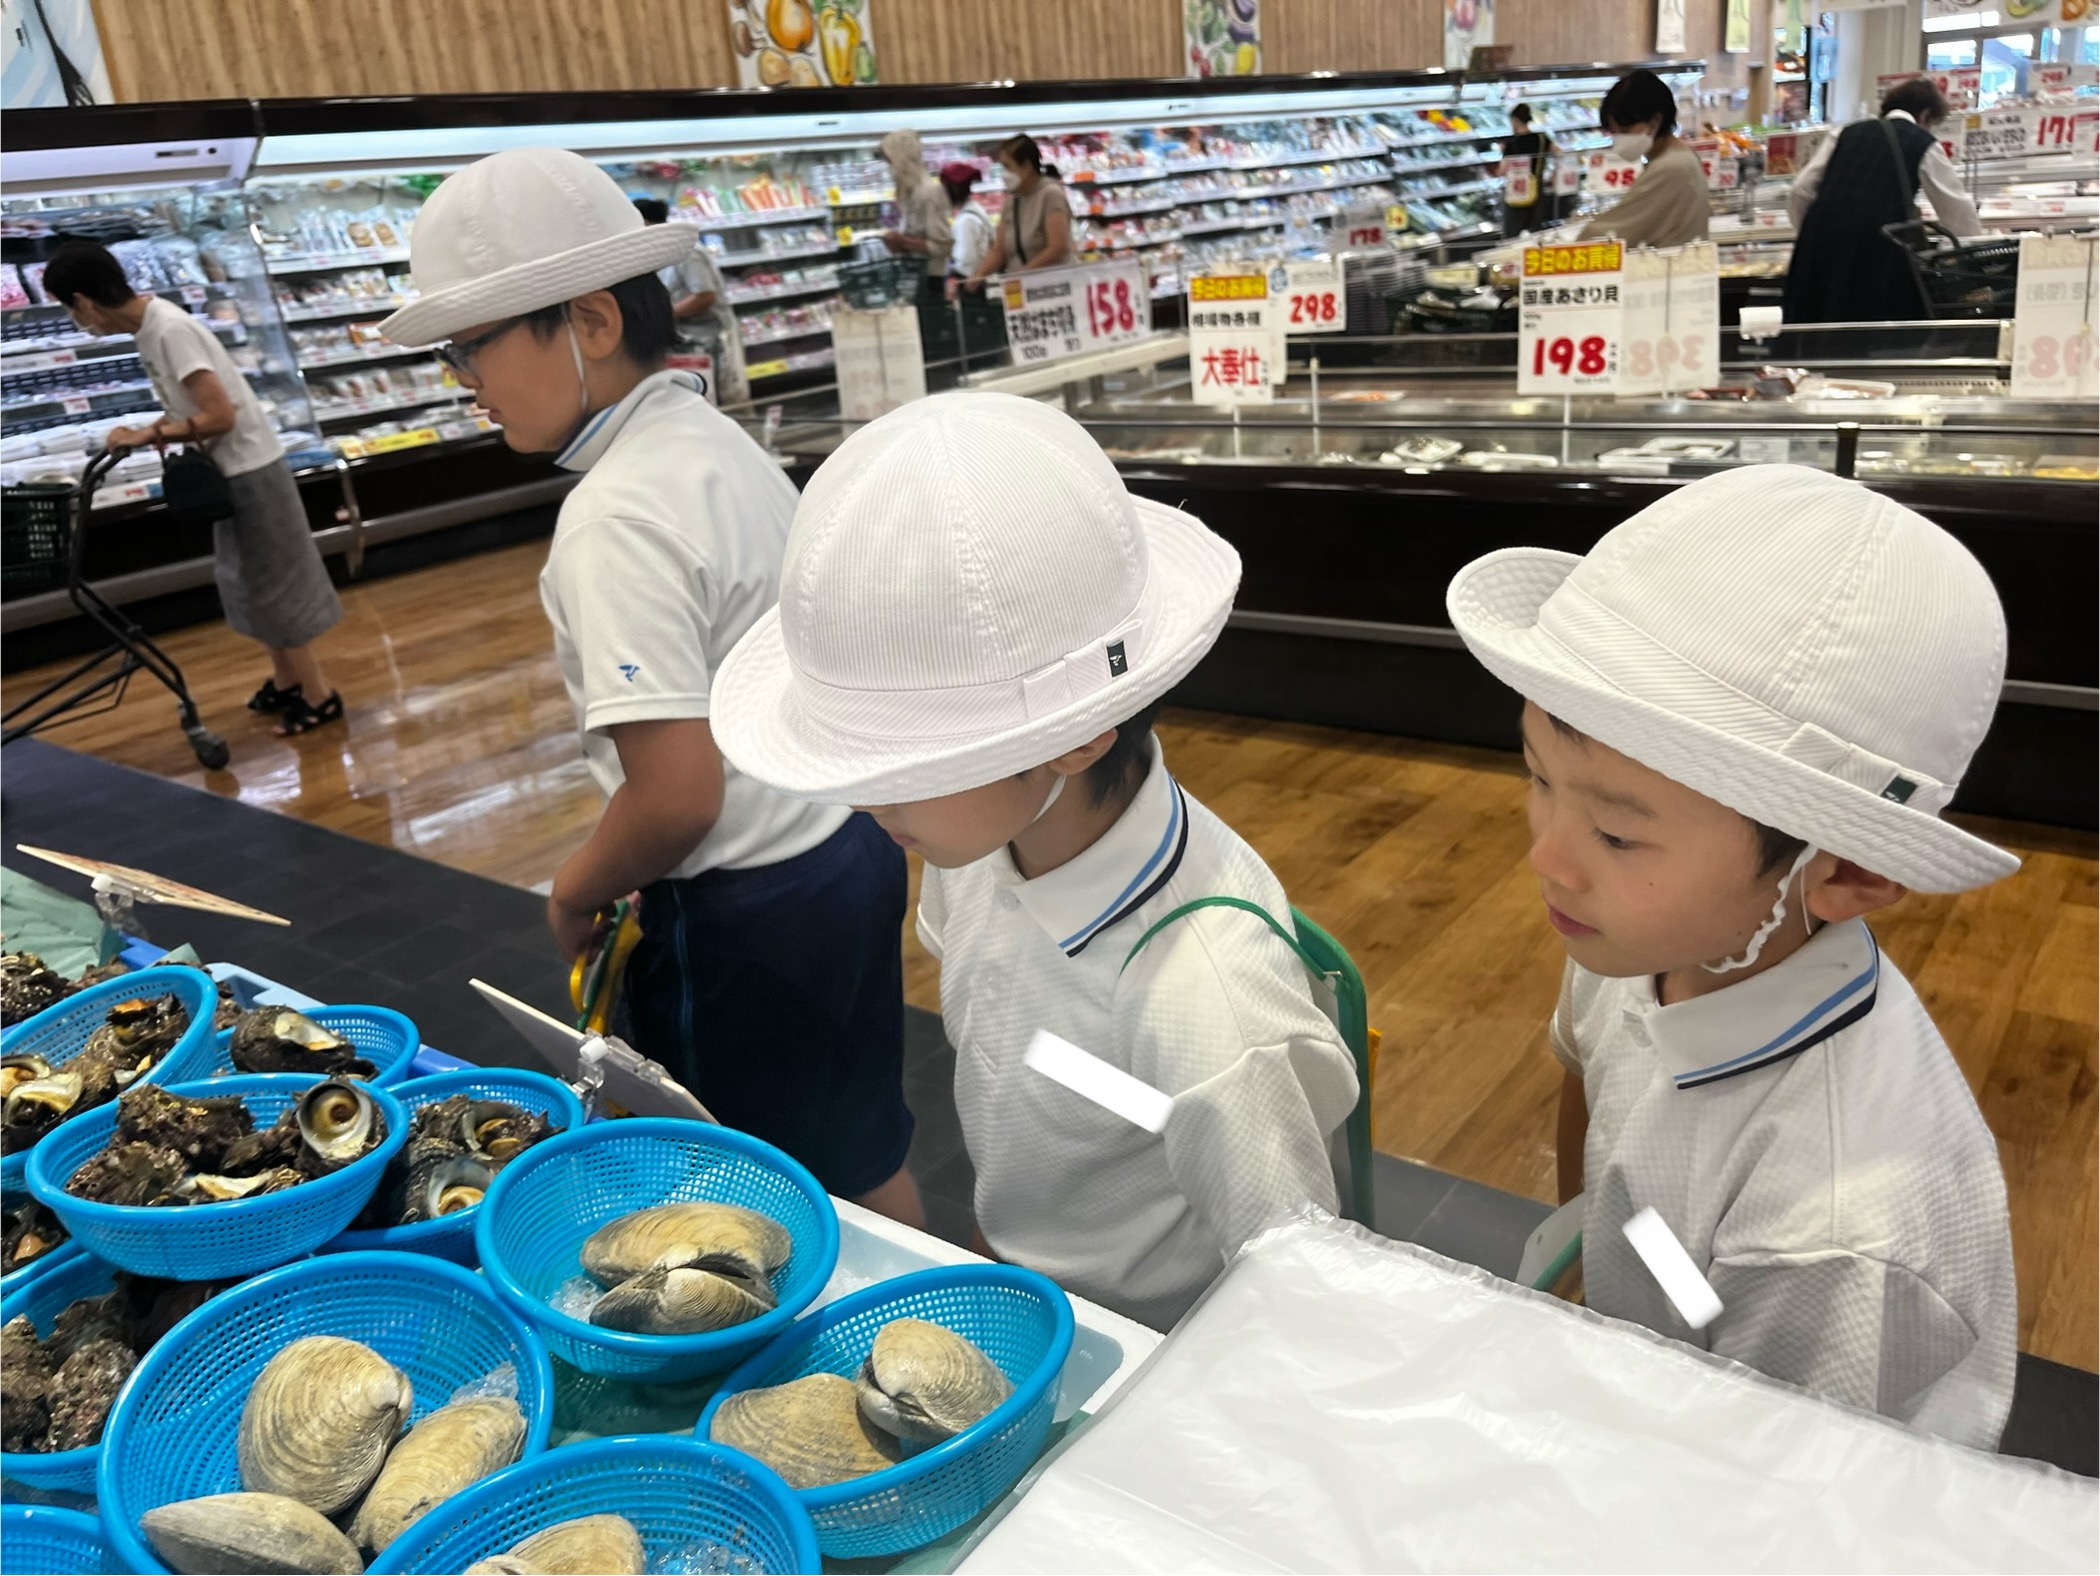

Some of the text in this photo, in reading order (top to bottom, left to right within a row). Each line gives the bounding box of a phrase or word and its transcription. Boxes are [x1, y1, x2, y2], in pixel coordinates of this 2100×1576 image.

[1087, 278, 1135, 338] 158
[1290, 292, 1336, 324] 298
[1523, 284, 1619, 305] 国産あさり貝
[1201, 347, 1260, 387] 大奉仕
[1533, 336, 1607, 376] 198
